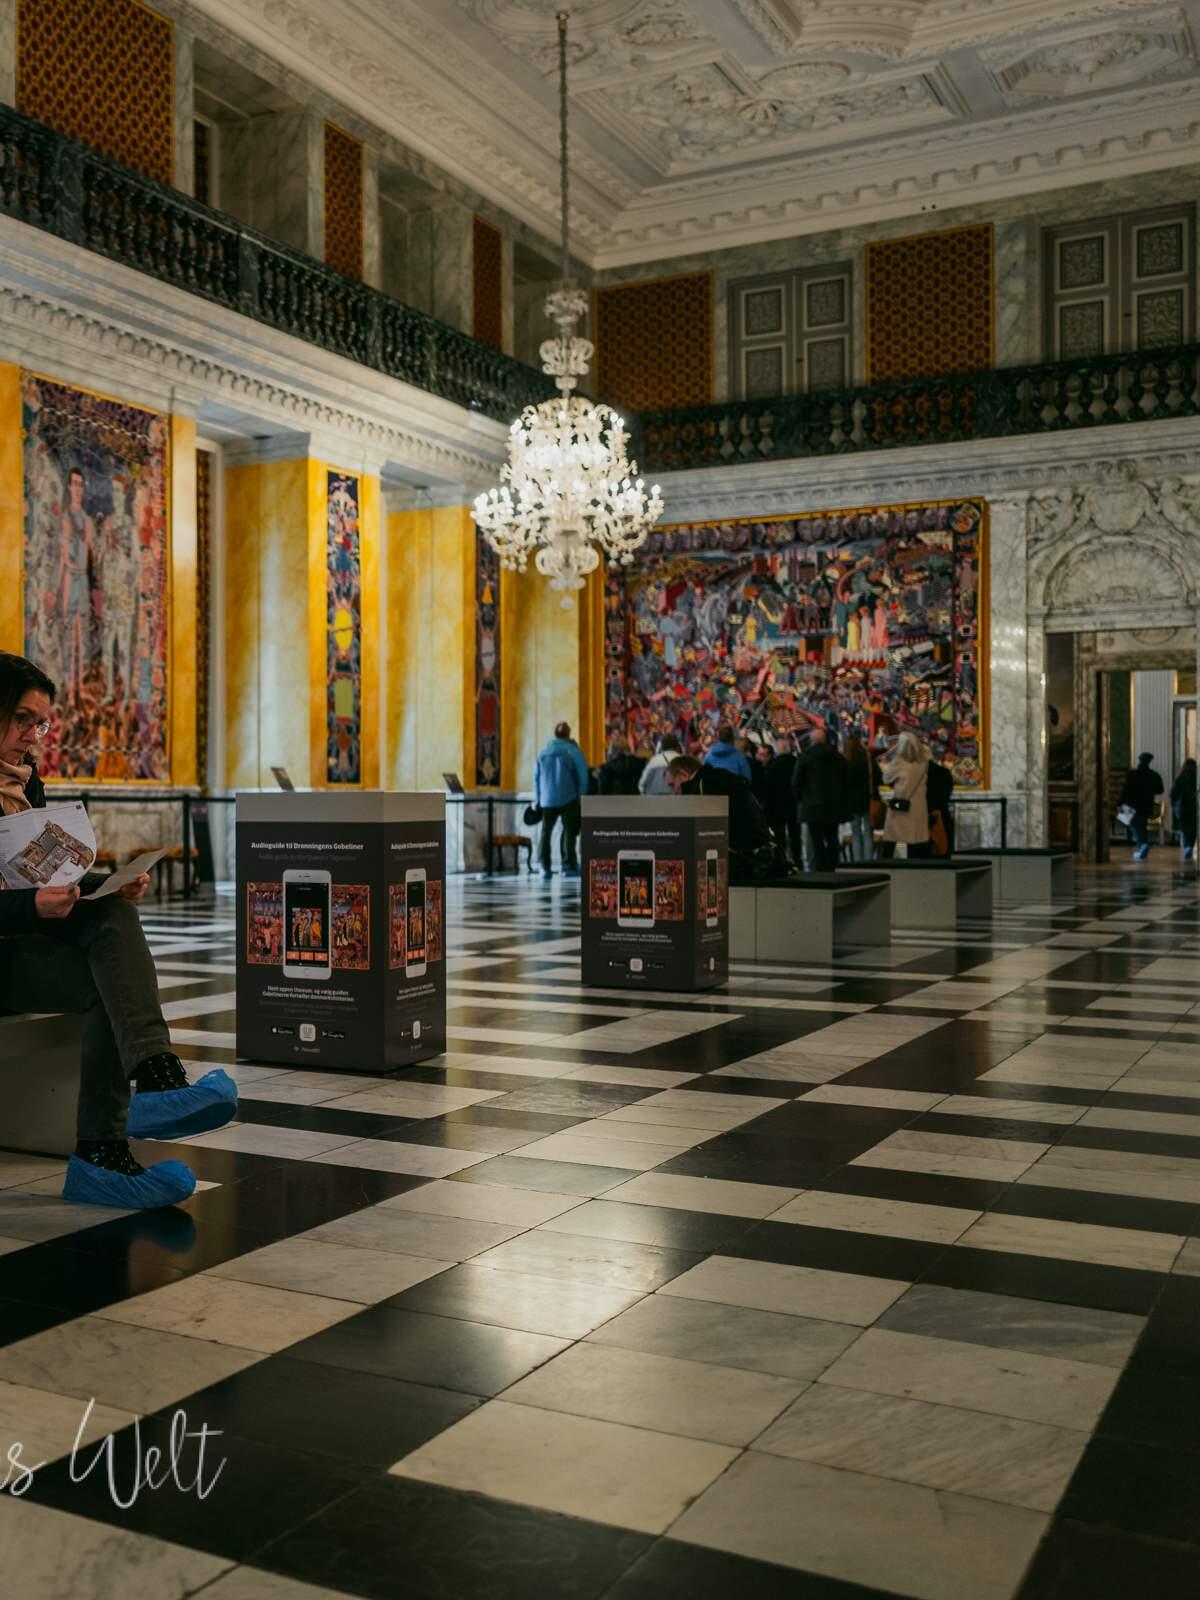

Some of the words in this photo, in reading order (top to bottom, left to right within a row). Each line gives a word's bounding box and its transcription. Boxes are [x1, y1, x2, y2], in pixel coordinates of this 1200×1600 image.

[251, 841, 285, 850] Audioguide
[293, 842, 333, 851] Dronningens
[333, 842, 364, 850] Gobeliner
